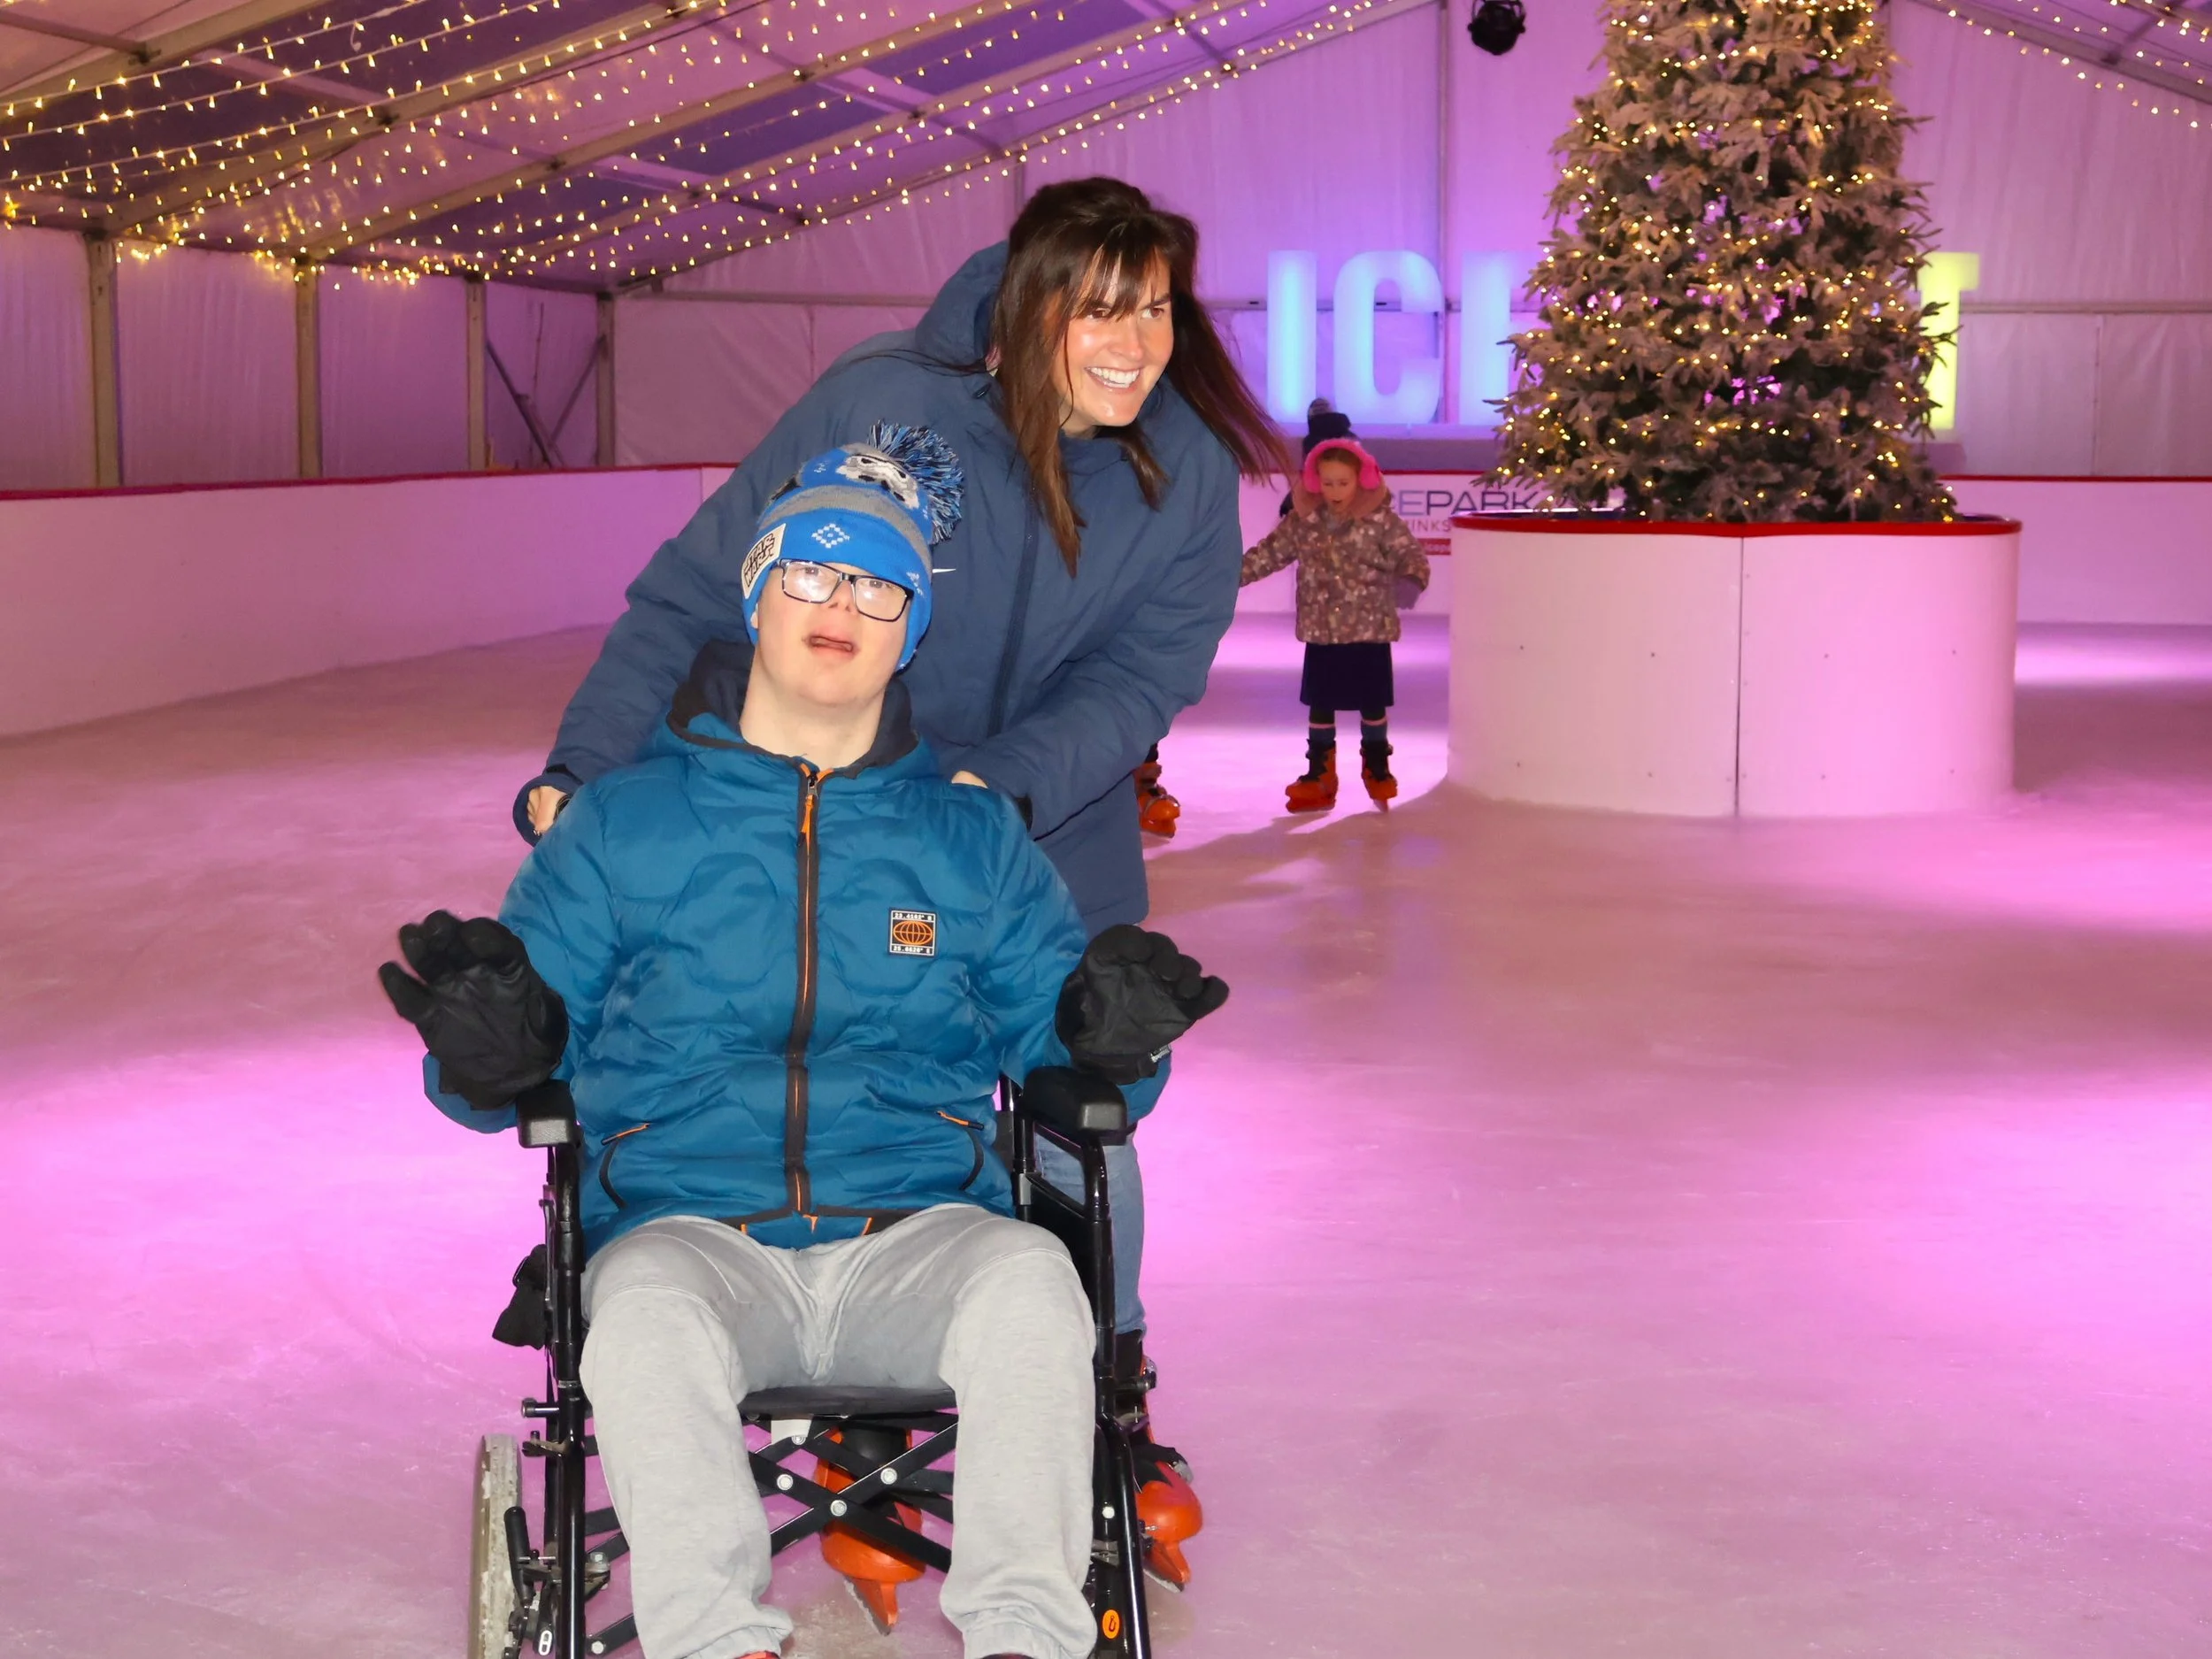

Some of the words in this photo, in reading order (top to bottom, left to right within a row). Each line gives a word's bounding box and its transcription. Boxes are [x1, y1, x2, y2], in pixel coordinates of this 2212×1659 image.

[1393, 490, 1539, 516] EPARK
[744, 533, 775, 575] STAR
[745, 542, 775, 588] WARS
